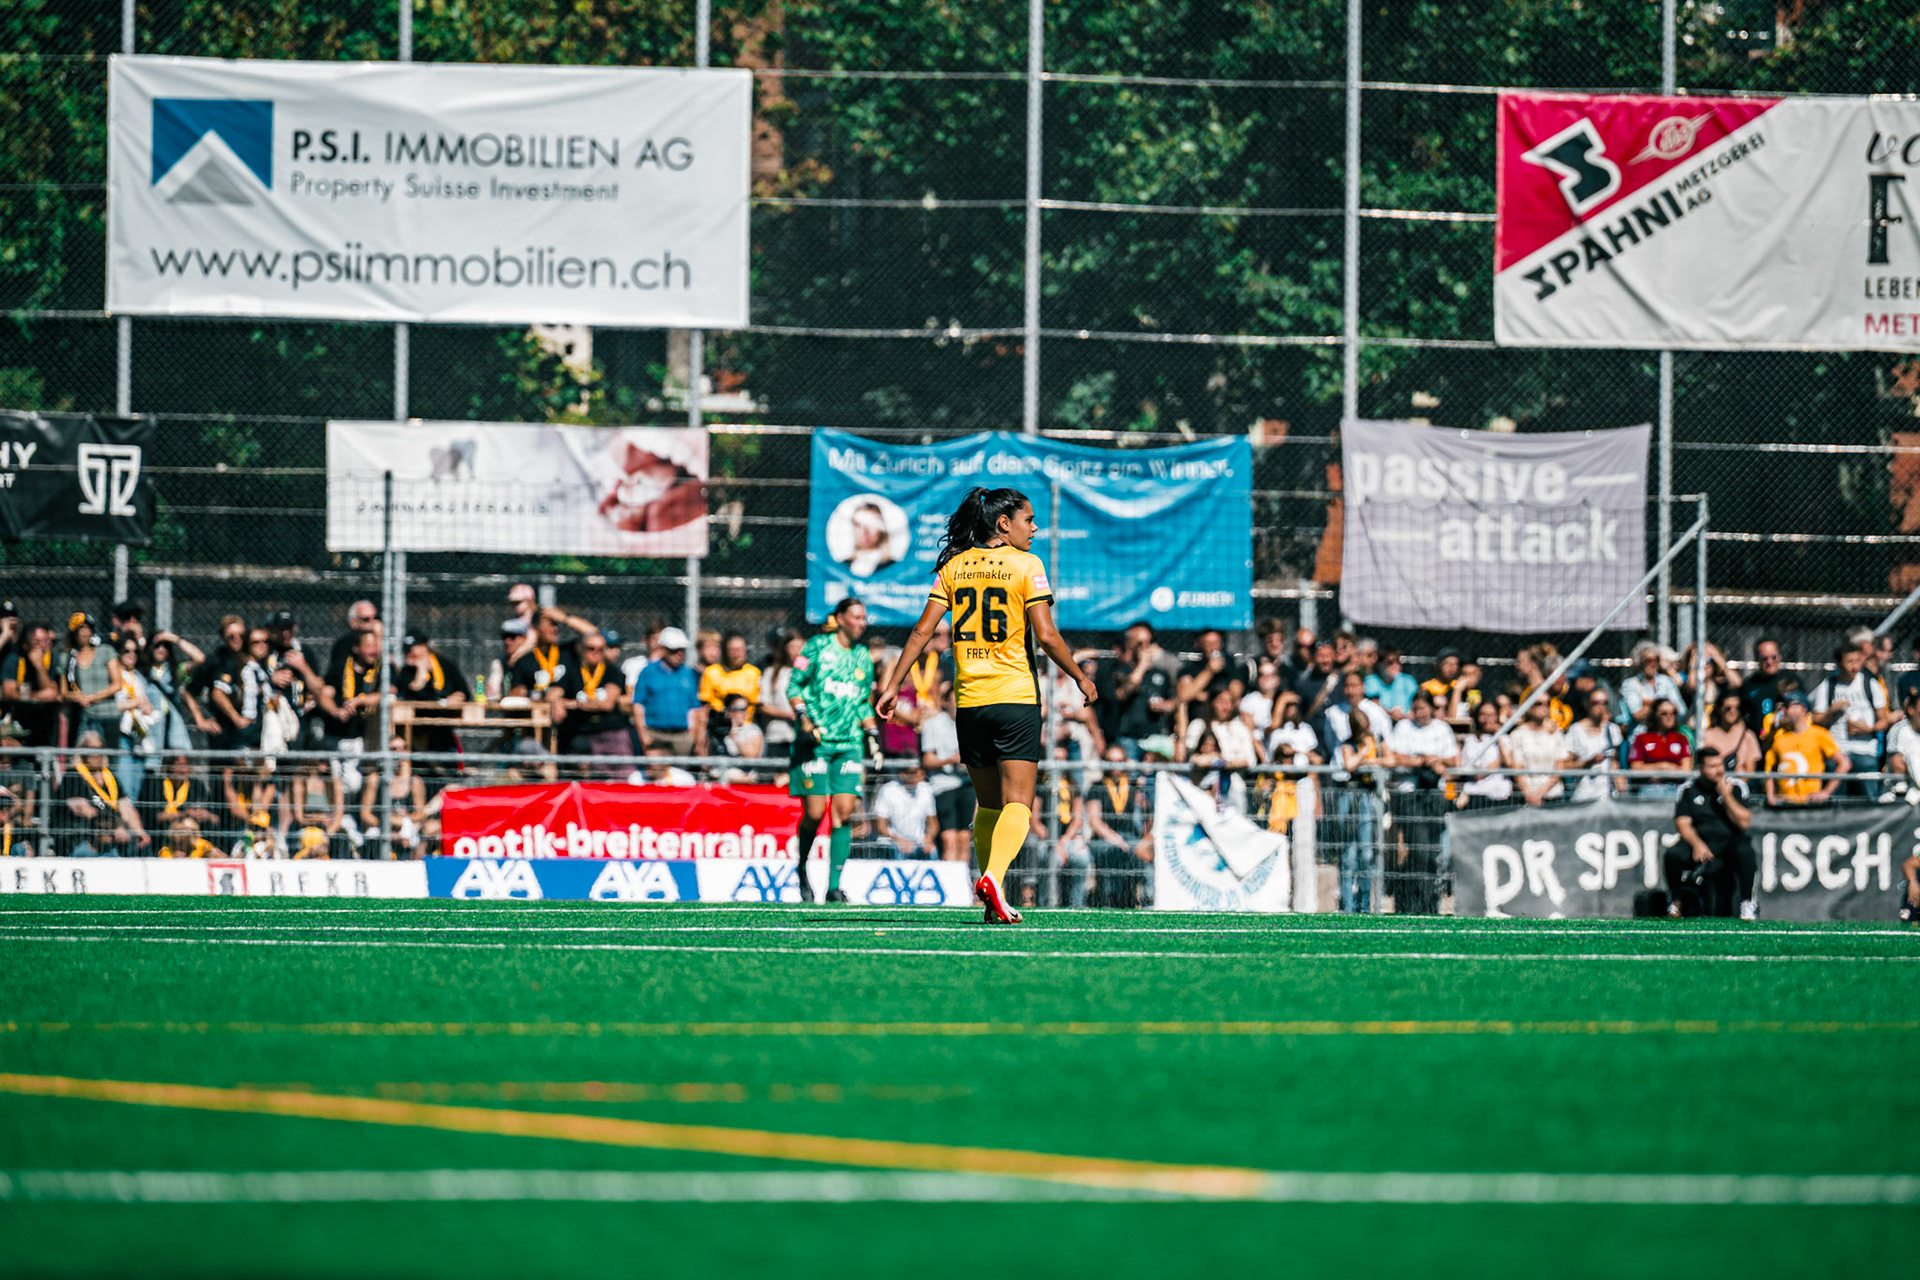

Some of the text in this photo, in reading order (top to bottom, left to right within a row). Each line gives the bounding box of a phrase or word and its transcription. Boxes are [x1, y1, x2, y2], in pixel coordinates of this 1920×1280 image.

[293, 130, 694, 171] P.S.I. IMMOBILIEN AG
[1675, 131, 1766, 195] METZGEREI
[290, 171, 620, 204] Property Suisse Investment
[1686, 189, 1714, 212] AG
[1521, 187, 1684, 302] SPAHNI
[150, 242, 692, 291] www.psiimmobilien.ch
[949, 450, 985, 476] auf
[953, 569, 1013, 581] Intermakler
[954, 586, 1007, 643] 26
[966, 647, 991, 659] FREY
[1482, 838, 1567, 918] DR
[1761, 831, 1892, 893] ISCH
